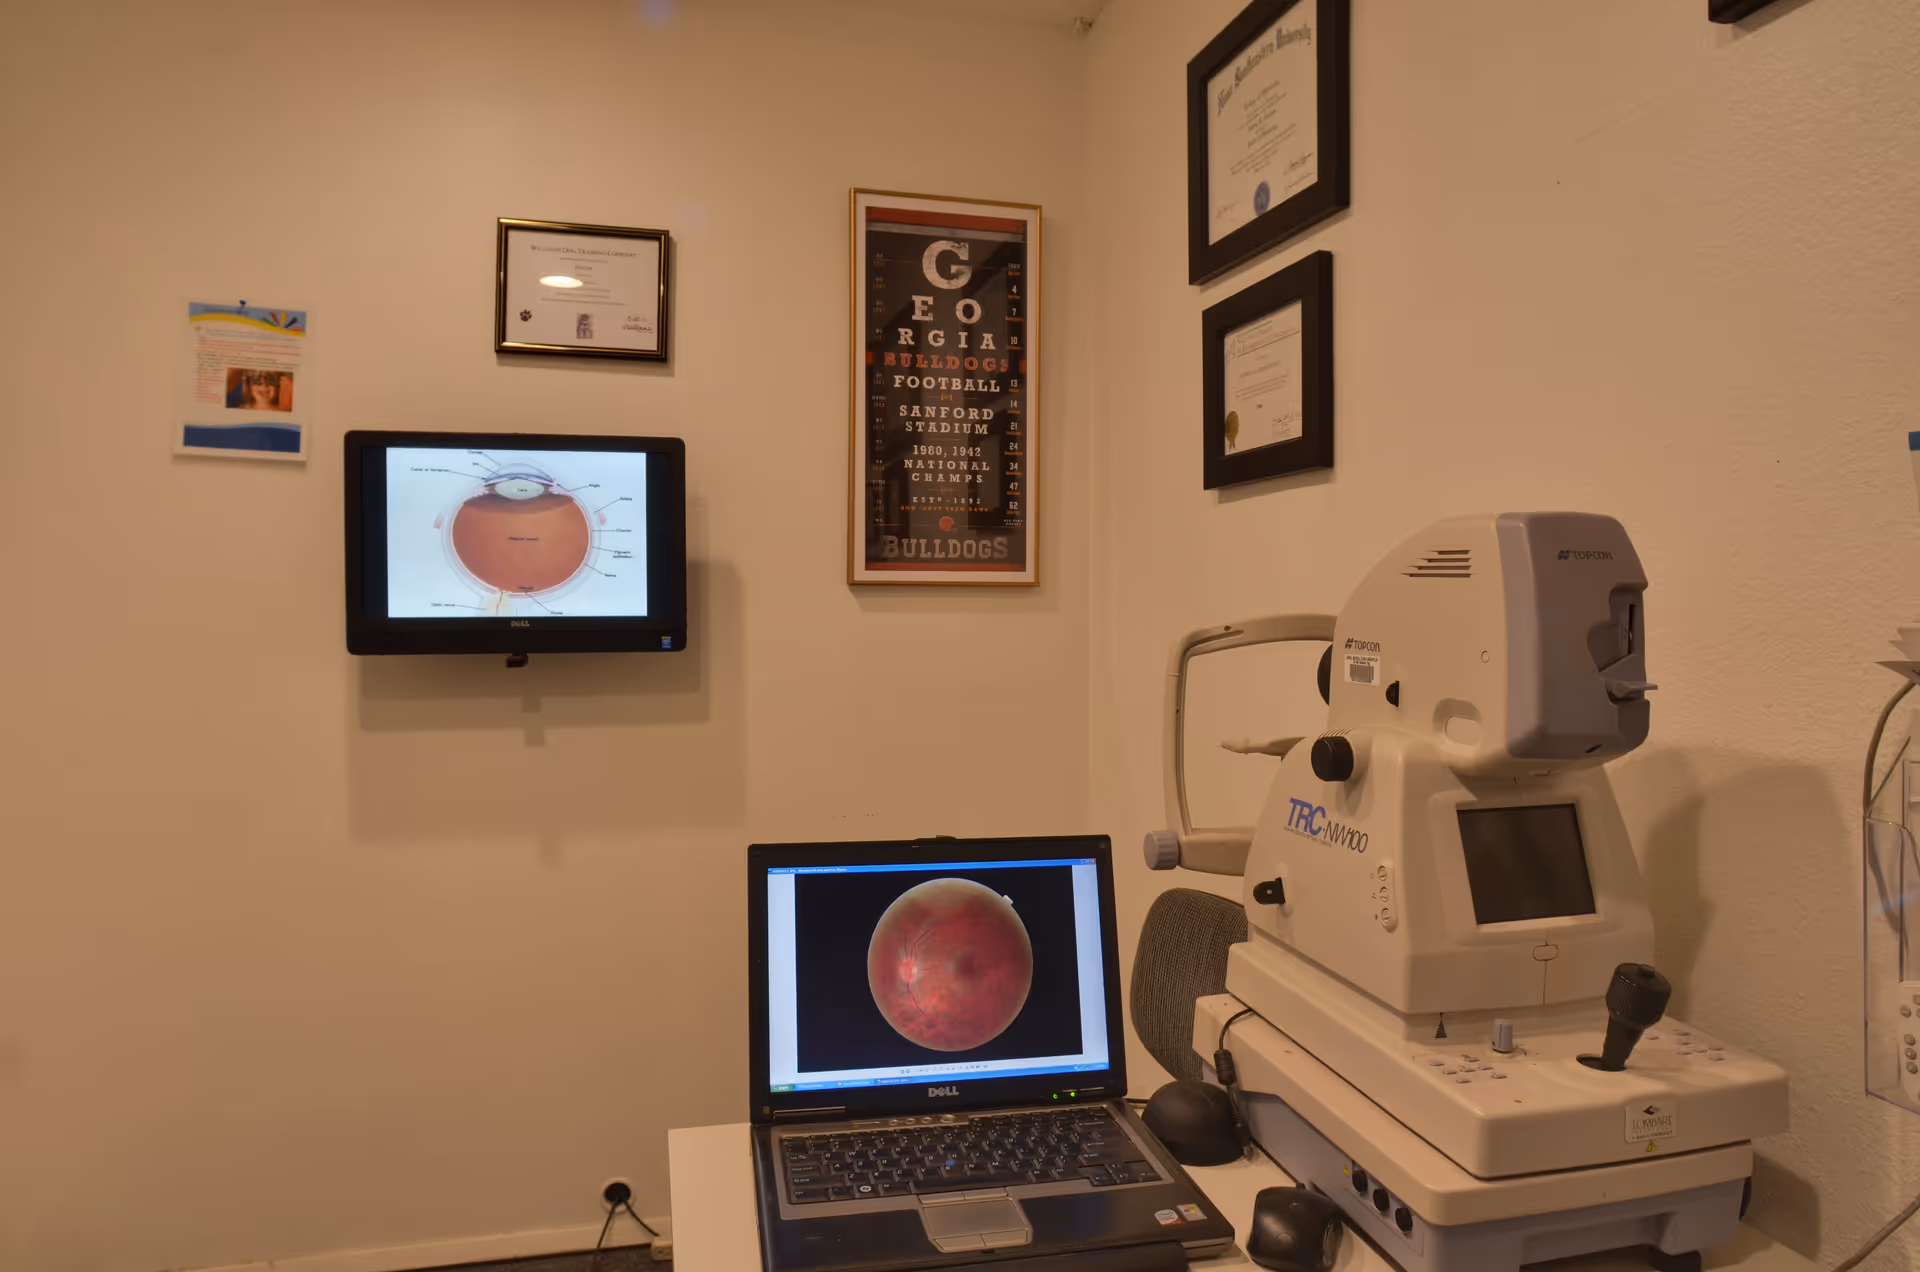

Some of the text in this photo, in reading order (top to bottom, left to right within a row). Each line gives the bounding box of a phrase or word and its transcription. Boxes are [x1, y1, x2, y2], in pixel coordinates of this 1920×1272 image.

[884, 351, 1009, 373] BULLDOGS
[893, 375, 1001, 393] FOOTBALL
[899, 404, 995, 421] SANFORD
[905, 421, 989, 435] STADIUM
[952, 446, 981, 457] 1942
[903, 459, 990, 471] NATIONAL
[911, 472, 983, 484] CHAMPS
[882, 534, 1008, 559] BULLDOGS
[1354, 639, 1381, 653] TOPCON
[928, 1085, 960, 1098] DELL
